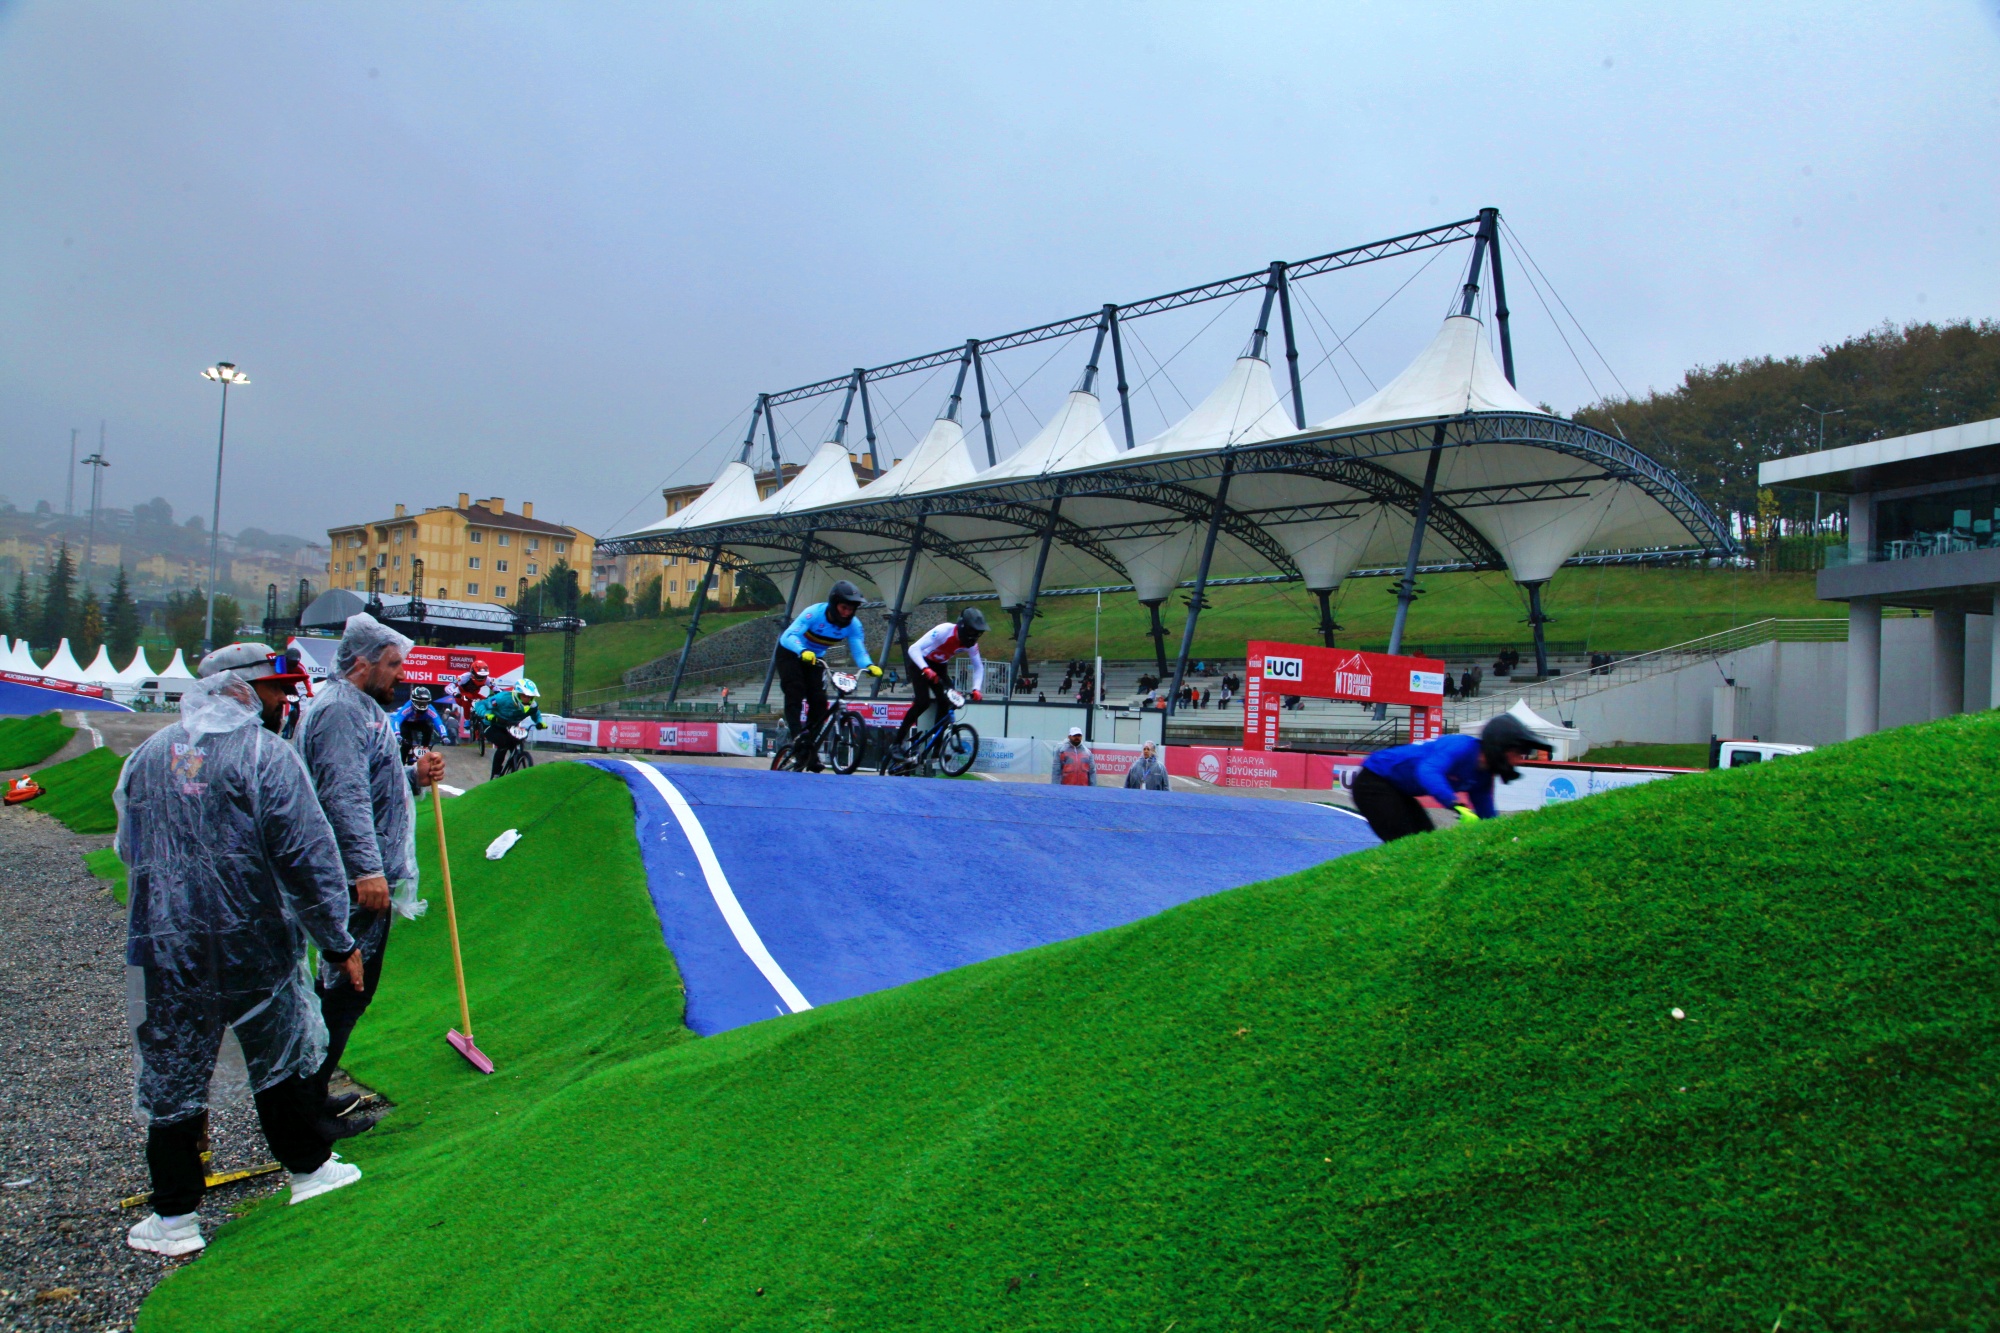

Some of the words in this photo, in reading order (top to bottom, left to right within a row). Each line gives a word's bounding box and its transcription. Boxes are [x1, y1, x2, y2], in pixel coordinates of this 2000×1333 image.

[408, 653, 446, 661] SUPERCROSS
[1273, 660, 1299, 677] UCI
[403, 670, 433, 681] INISH
[875, 706, 887, 715] UCI
[555, 724, 566, 736] UCI
[663, 730, 676, 742] UCI
[1226, 755, 1264, 766] SAKARYA
[1114, 764, 1126, 772] CUP
[1226, 765, 1278, 778] BÜYÜKŞEHİR
